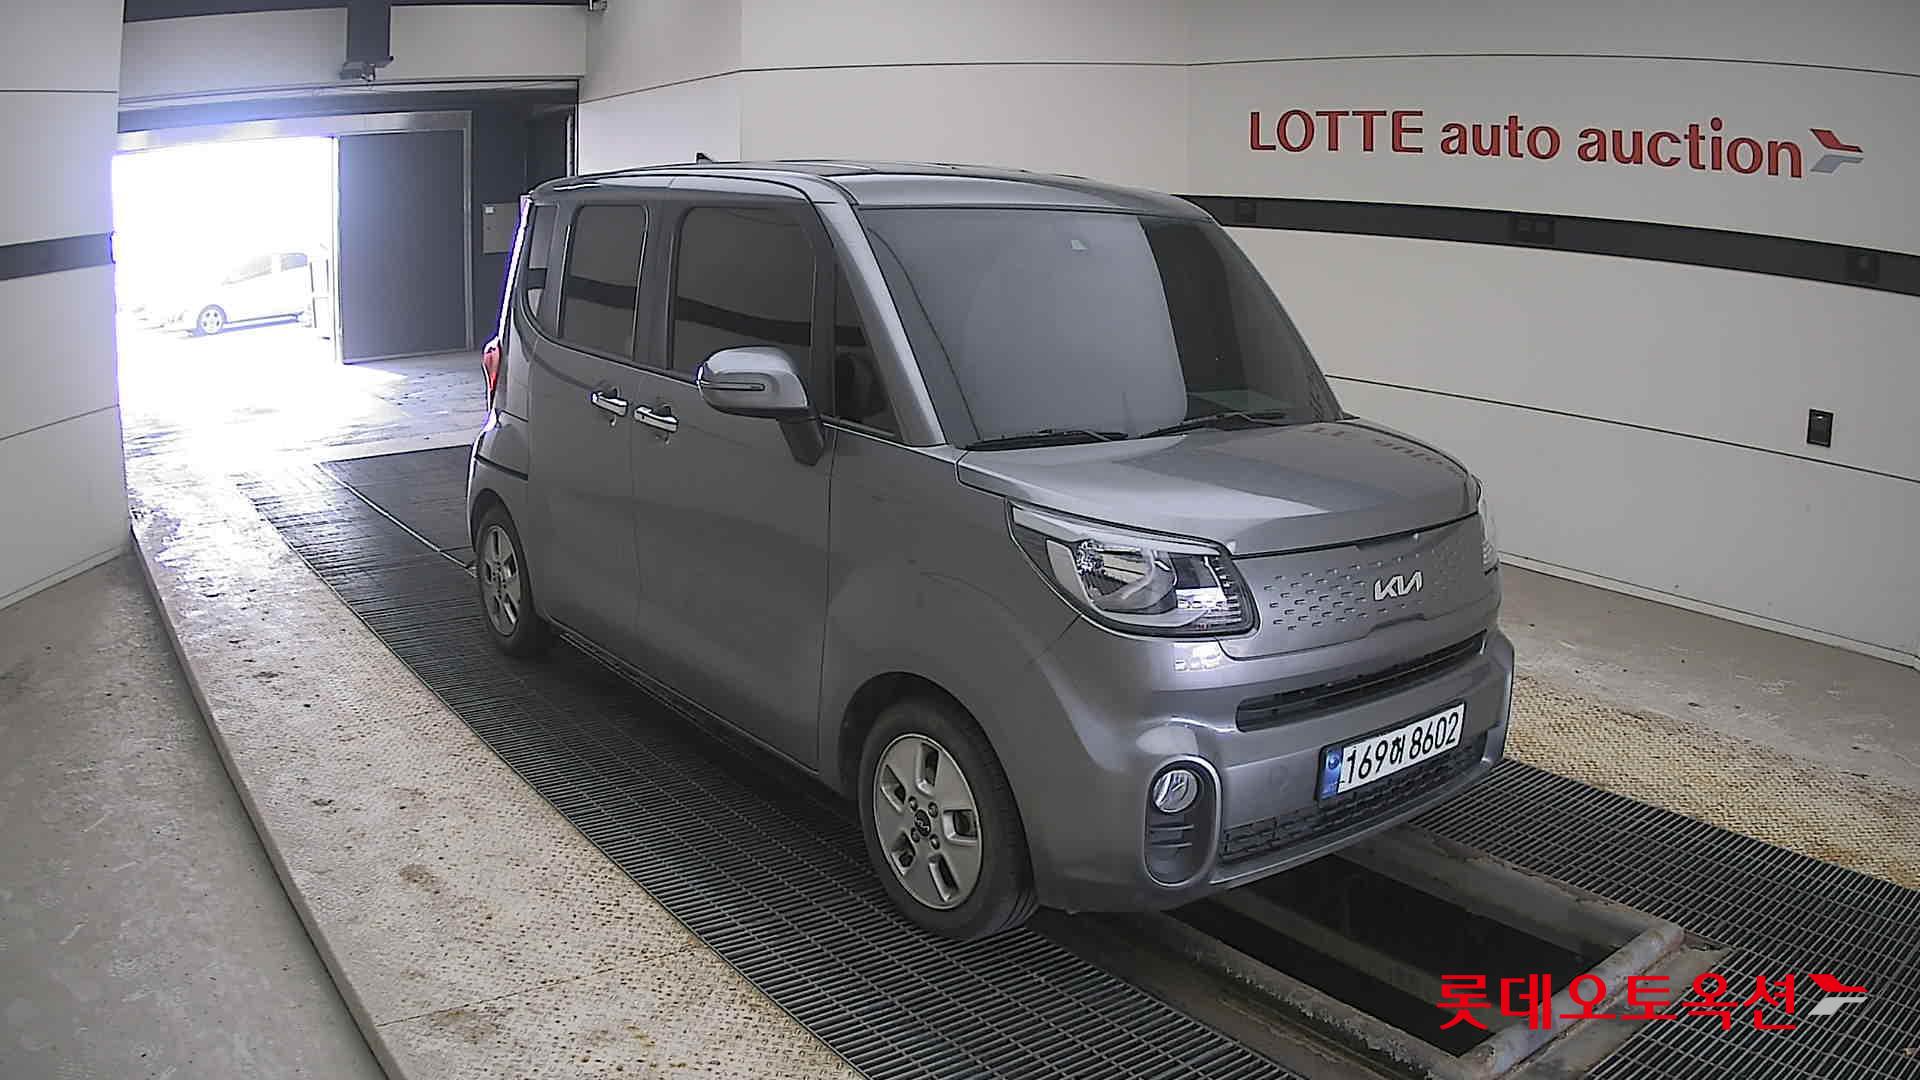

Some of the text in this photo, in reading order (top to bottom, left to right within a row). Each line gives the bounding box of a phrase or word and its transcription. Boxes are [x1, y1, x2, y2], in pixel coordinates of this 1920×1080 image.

[1249, 110, 1803, 178] LOTTE auto auction
[1373, 570, 1423, 601] KIA
